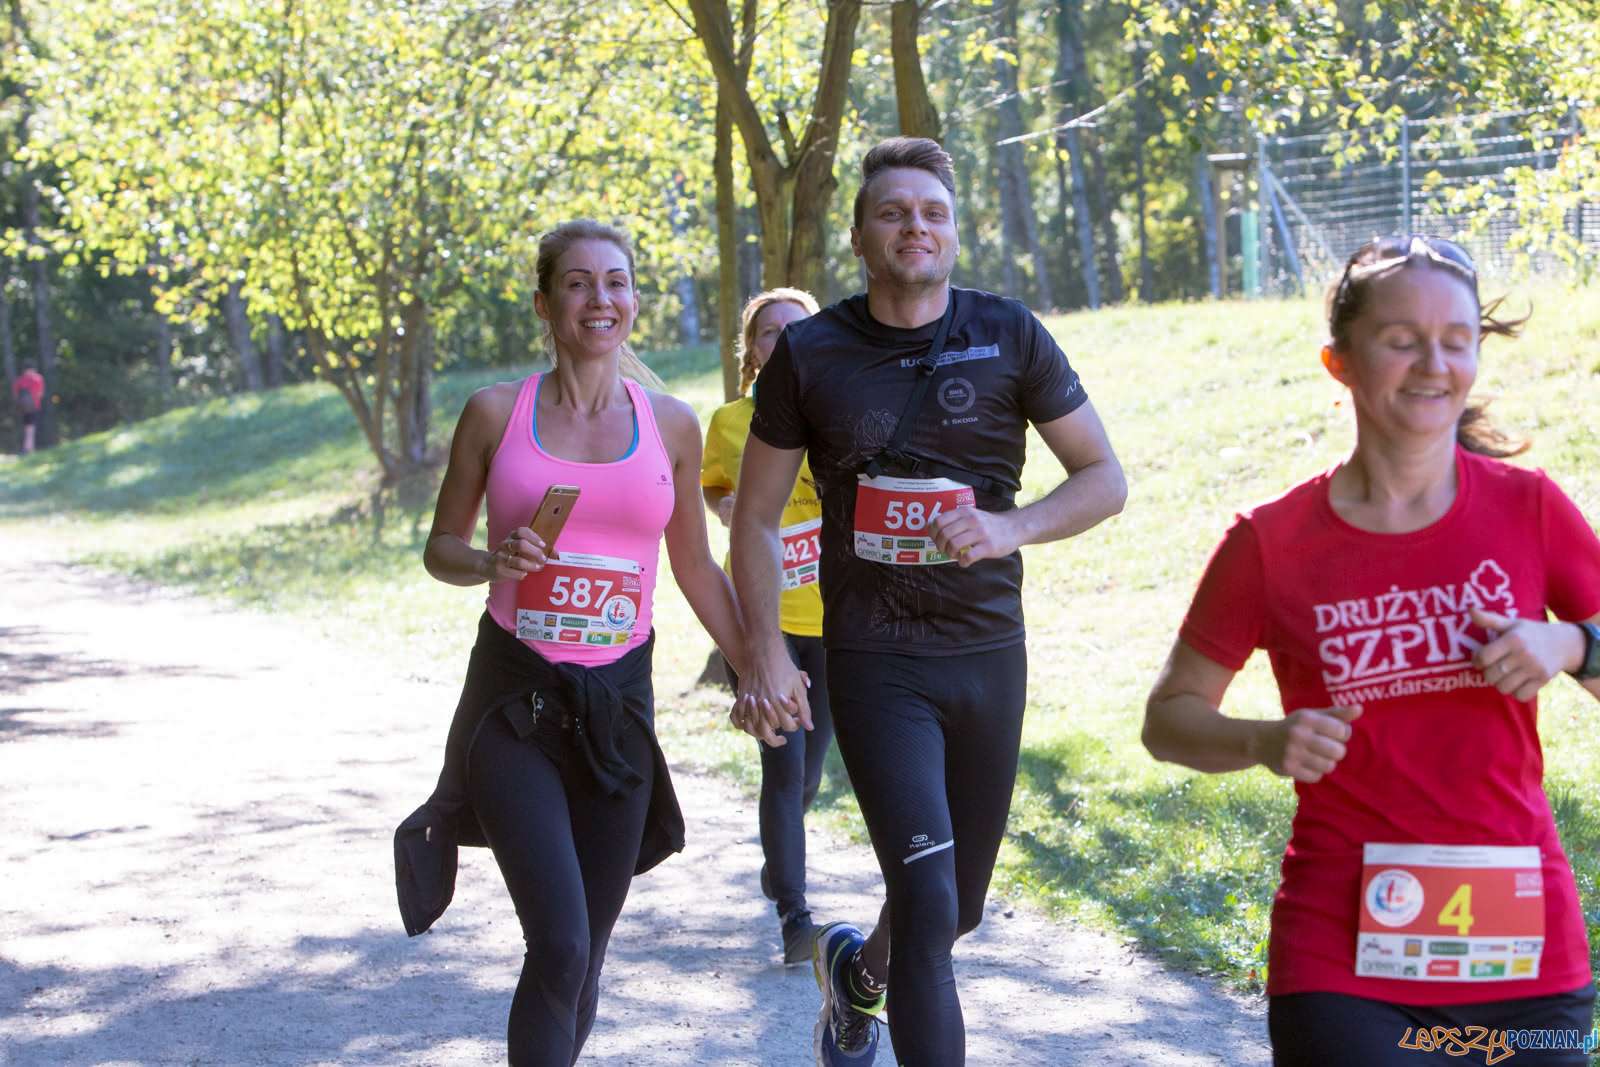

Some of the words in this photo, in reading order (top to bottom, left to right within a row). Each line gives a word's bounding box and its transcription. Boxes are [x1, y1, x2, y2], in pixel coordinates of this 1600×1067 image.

[549, 575, 614, 609] 587
[1313, 582, 1486, 633] DRUŻYNA
[1319, 608, 1519, 684] SZPIK
[1437, 883, 1475, 937] 4
